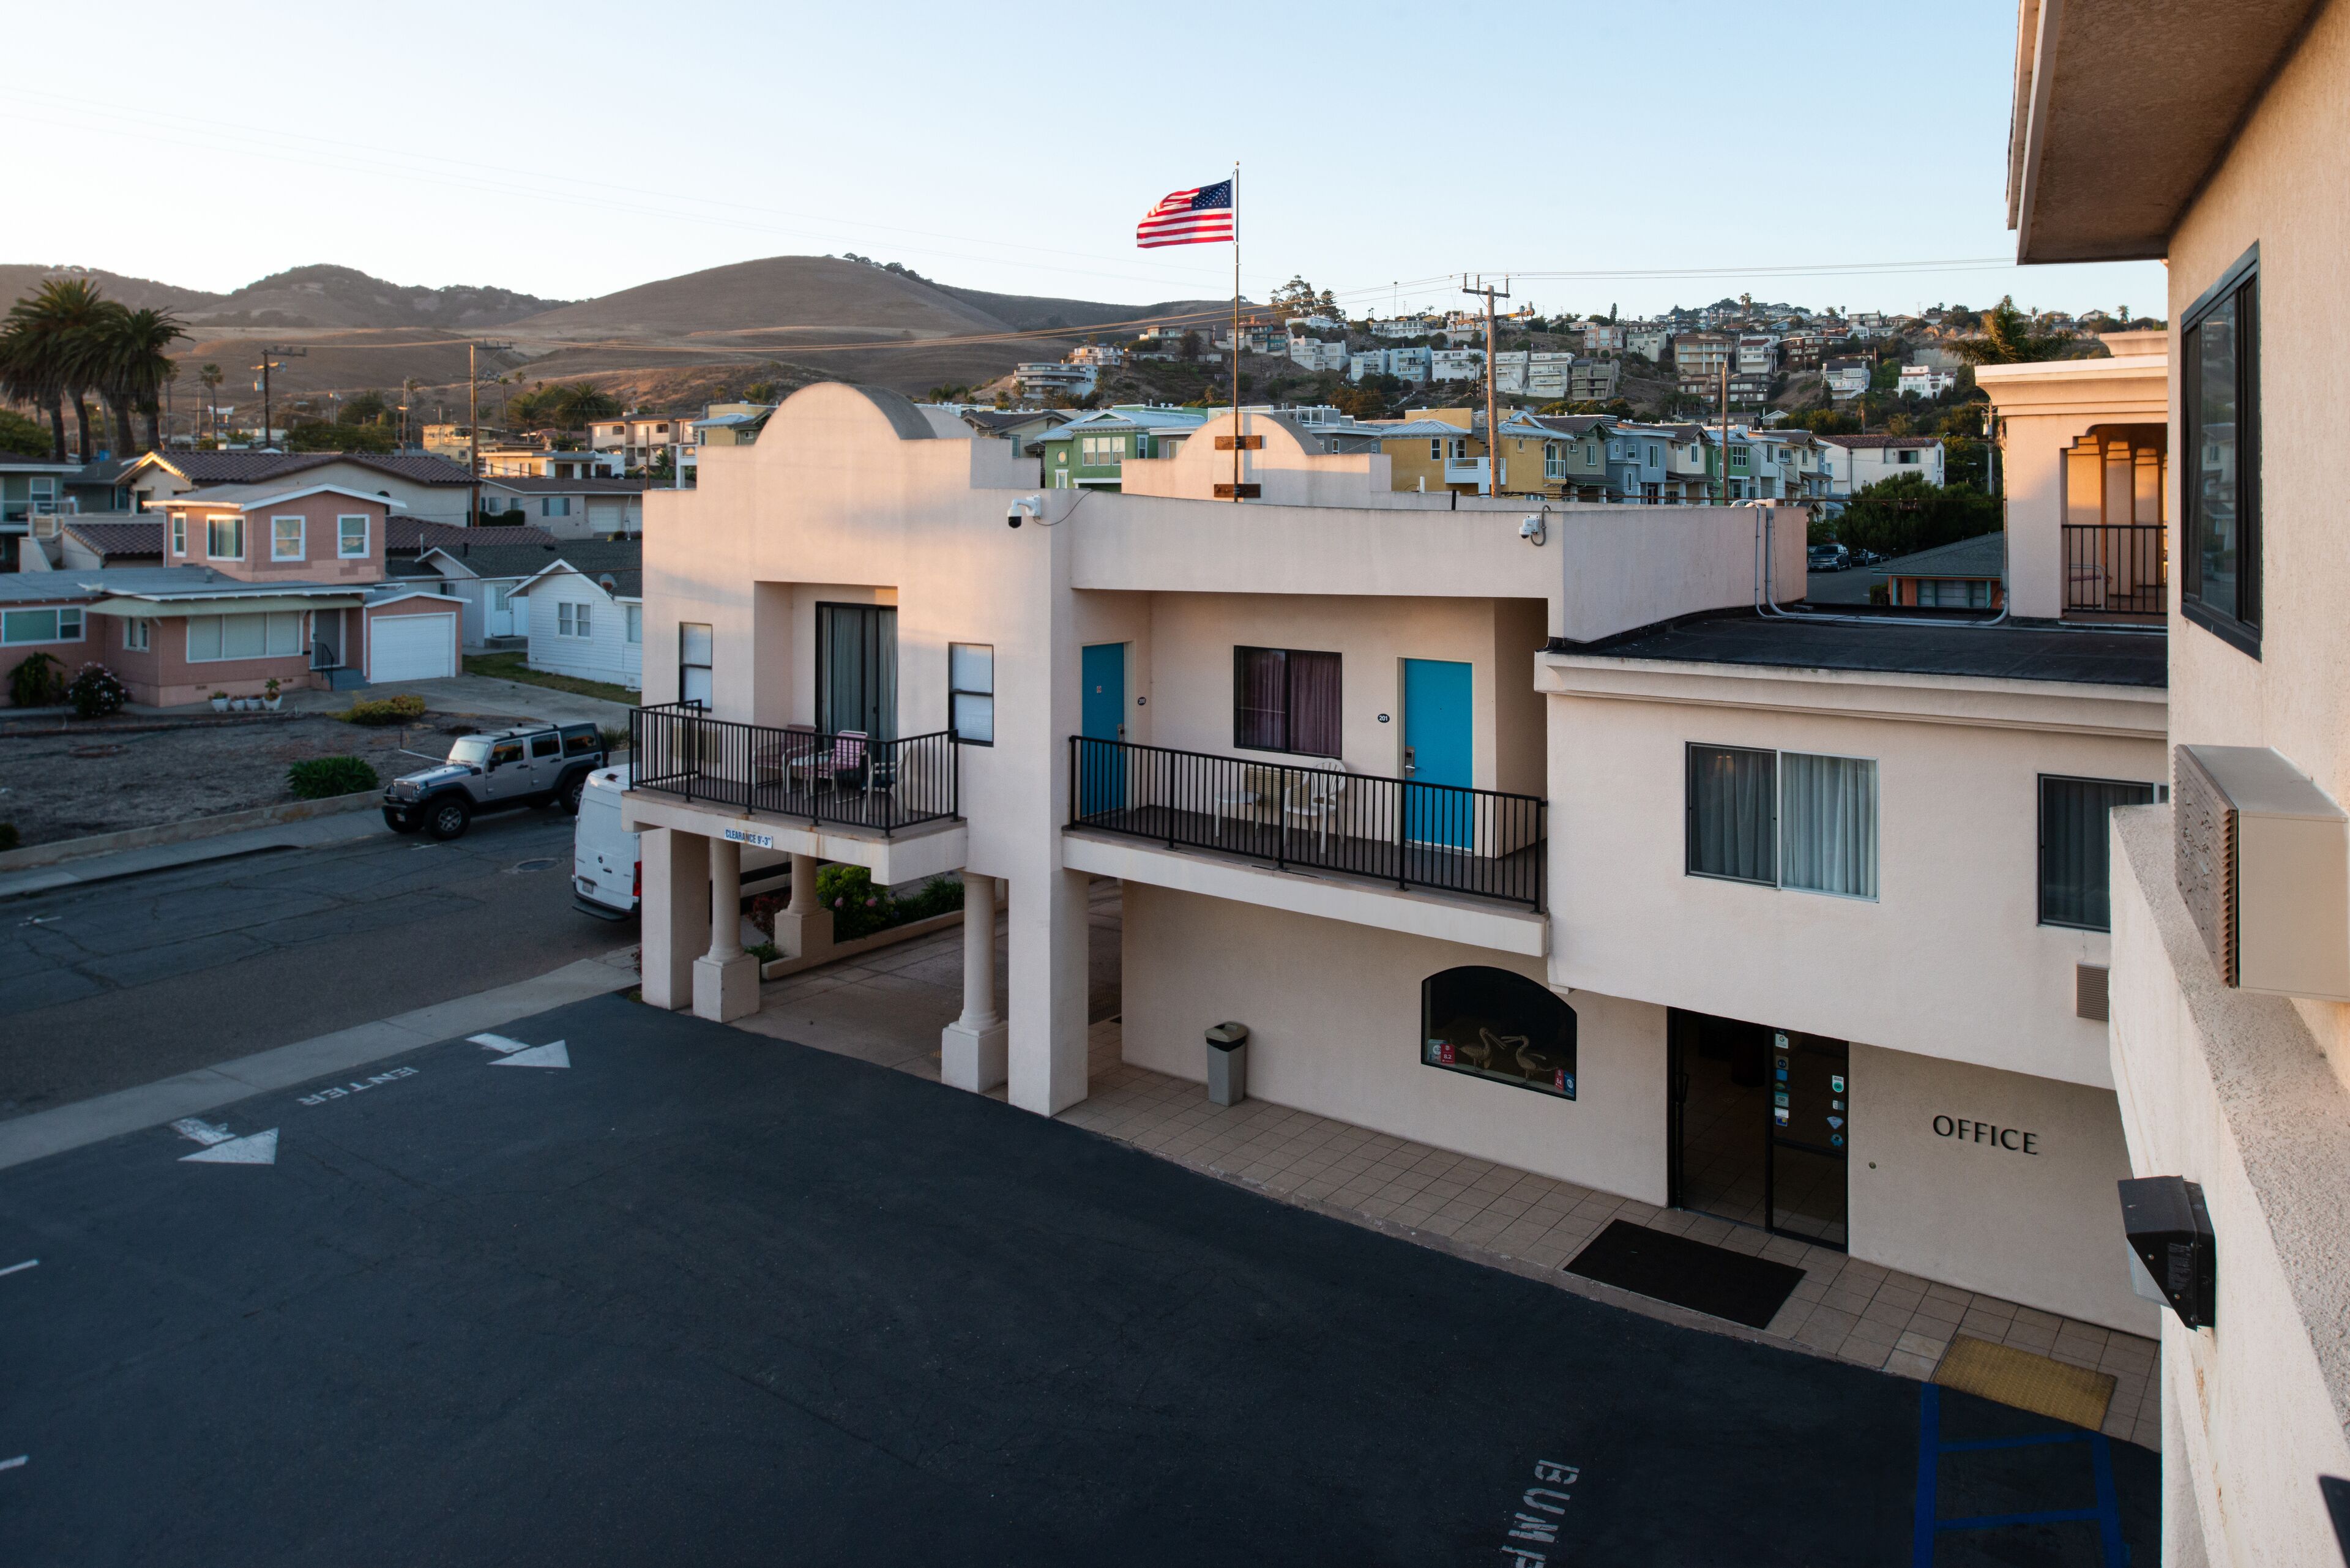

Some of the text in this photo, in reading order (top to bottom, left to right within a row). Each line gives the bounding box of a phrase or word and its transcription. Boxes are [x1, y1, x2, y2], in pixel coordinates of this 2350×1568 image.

[725, 829, 756, 843] CLEARANCE
[297, 1067, 419, 1105] ENTER
[1933, 1115, 2038, 1155] OFFICE
